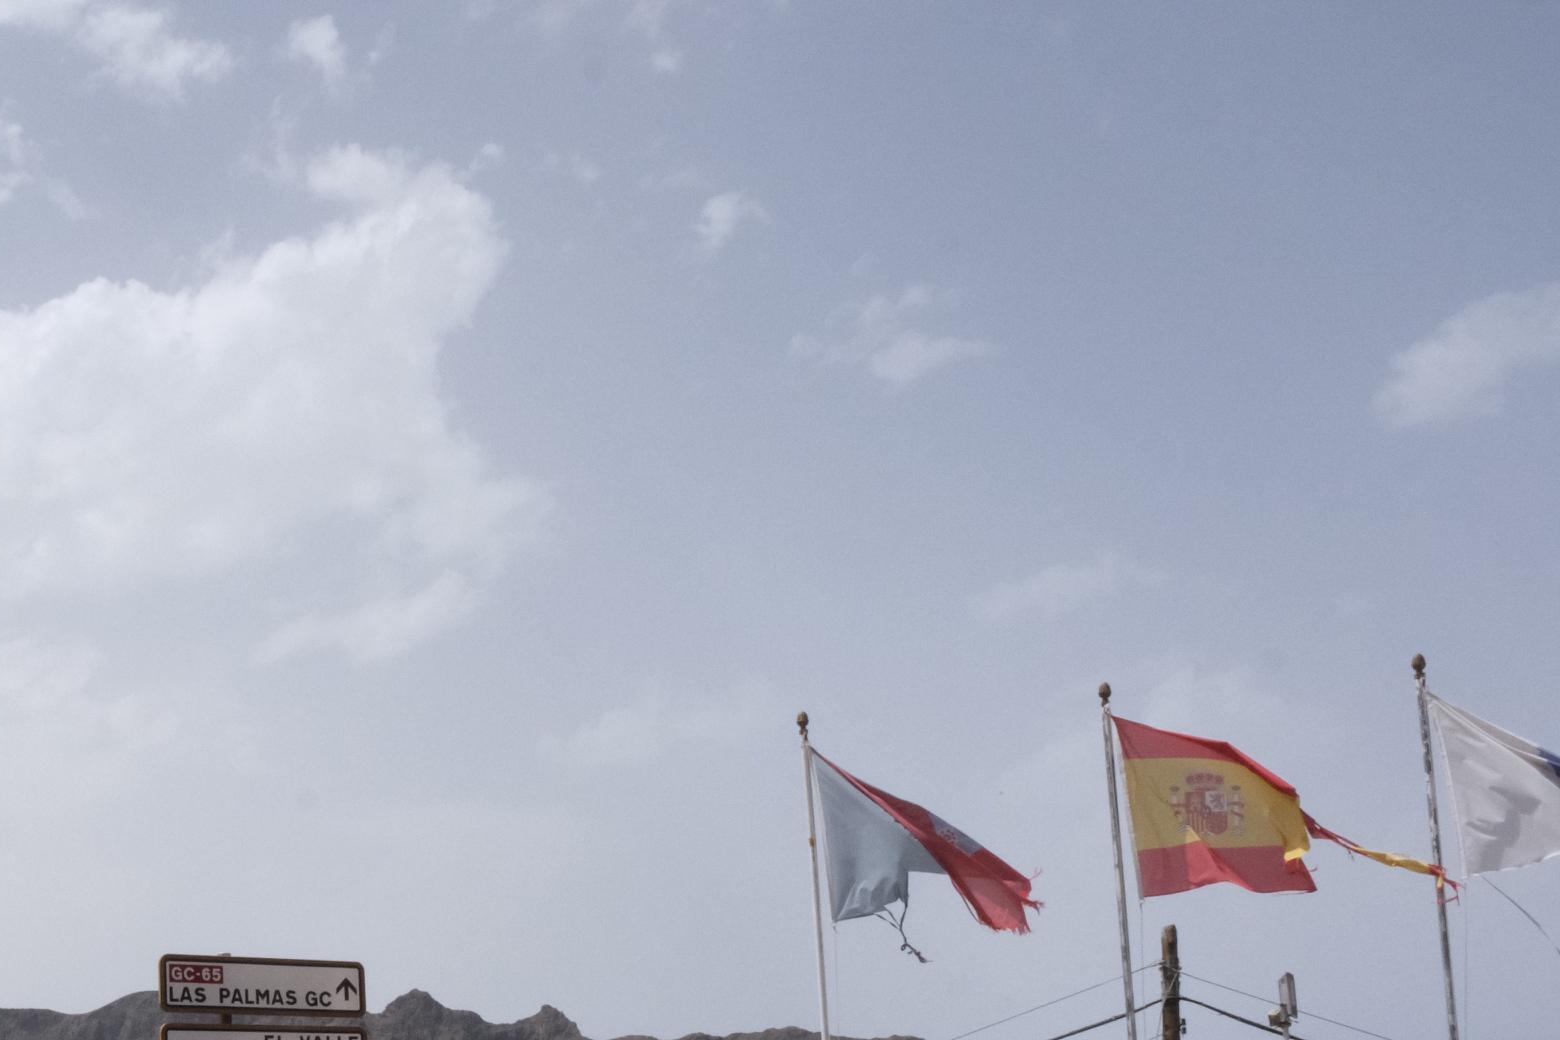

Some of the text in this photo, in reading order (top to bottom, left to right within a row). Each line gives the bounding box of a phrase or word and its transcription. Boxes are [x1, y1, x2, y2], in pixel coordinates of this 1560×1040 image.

[171, 967, 222, 982] GC-65
[169, 986, 333, 1007] LAS PALMAS GC
